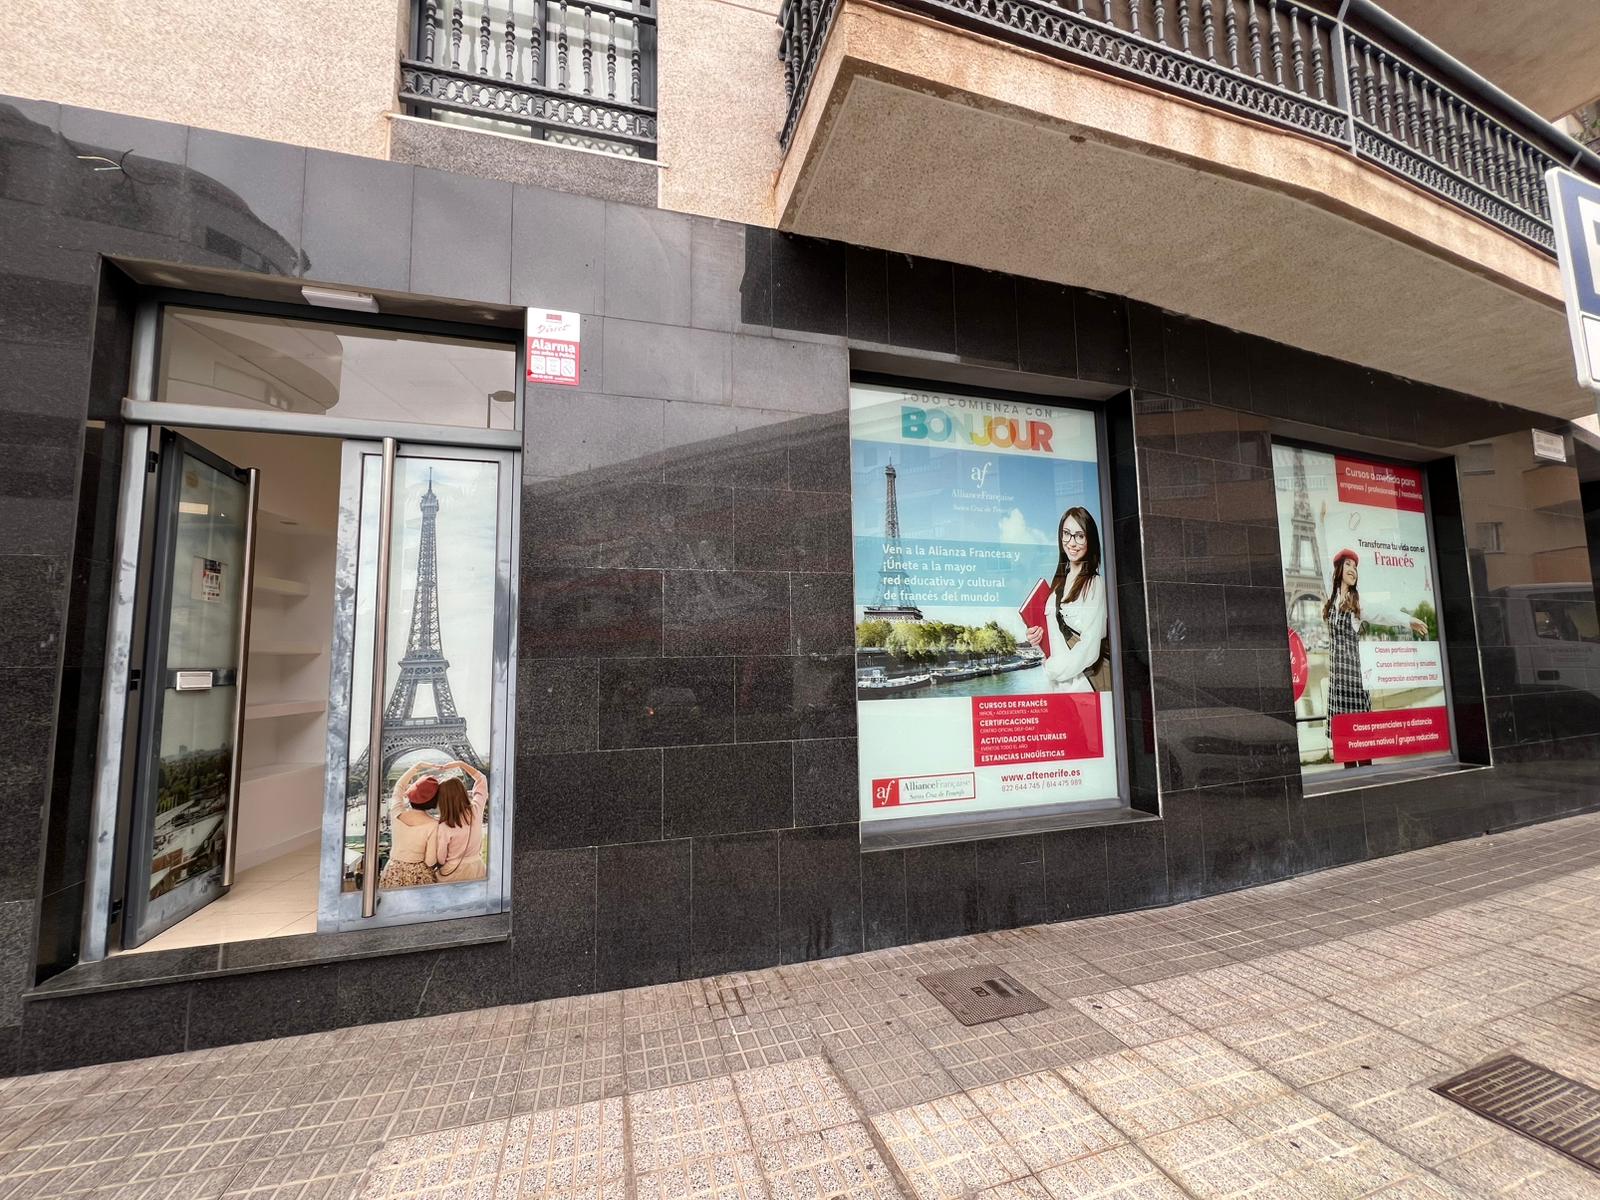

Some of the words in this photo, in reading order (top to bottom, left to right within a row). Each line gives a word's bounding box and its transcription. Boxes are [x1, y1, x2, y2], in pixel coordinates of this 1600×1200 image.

[531, 338, 576, 354] Alarma
[902, 392, 940, 404] TODO
[948, 398, 1019, 414] COMIENZA
[1026, 407, 1053, 418] CON
[900, 406, 1054, 452] BONJOUR
[1345, 467, 1370, 479] Cursos
[1401, 478, 1416, 488] para
[1340, 482, 1364, 491] empresas
[1368, 486, 1398, 496] profesionales
[1358, 539, 1391, 550] Transforma
[1398, 543, 1409, 551] vida
[882, 544, 902, 554] Ven
[906, 547, 912, 555] a
[915, 545, 925, 555] la
[928, 546, 966, 557] Alianza
[969, 548, 1012, 559] Francesa
[1014, 551, 1020, 562] y
[1374, 552, 1414, 568] Francés
[883, 557, 919, 572] ¡Únete
[932, 561, 941, 571] la
[944, 563, 976, 575] mayor
[883, 575, 900, 585] red
[904, 575, 955, 587] educativa
[958, 579, 964, 589] y
[967, 577, 1005, 587] cultural
[884, 590, 897, 600] de
[900, 590, 938, 601] francés
[942, 591, 957, 601] del
[961, 592, 1000, 602] mundo!
[1018, 698, 1048, 707] FRANCÉS
[980, 718, 1039, 726] CERTIFICACIONES
[1353, 723, 1371, 732] Clases
[1372, 720, 1402, 732] presenciales
[1411, 717, 1432, 726] distancia
[981, 736, 1026, 744] ACTIVIDADES
[1027, 733, 1067, 742] CULTURALES
[1348, 739, 1375, 749] Profesores
[1376, 737, 1394, 745] nativos
[1399, 735, 1415, 744] grupos
[981, 752, 1019, 762] ESTANCIAS
[1020, 750, 1065, 759] LINGÜÍSTICAS
[1001, 769, 1081, 782] www.aftenerife.es
[876, 780, 895, 805] af
